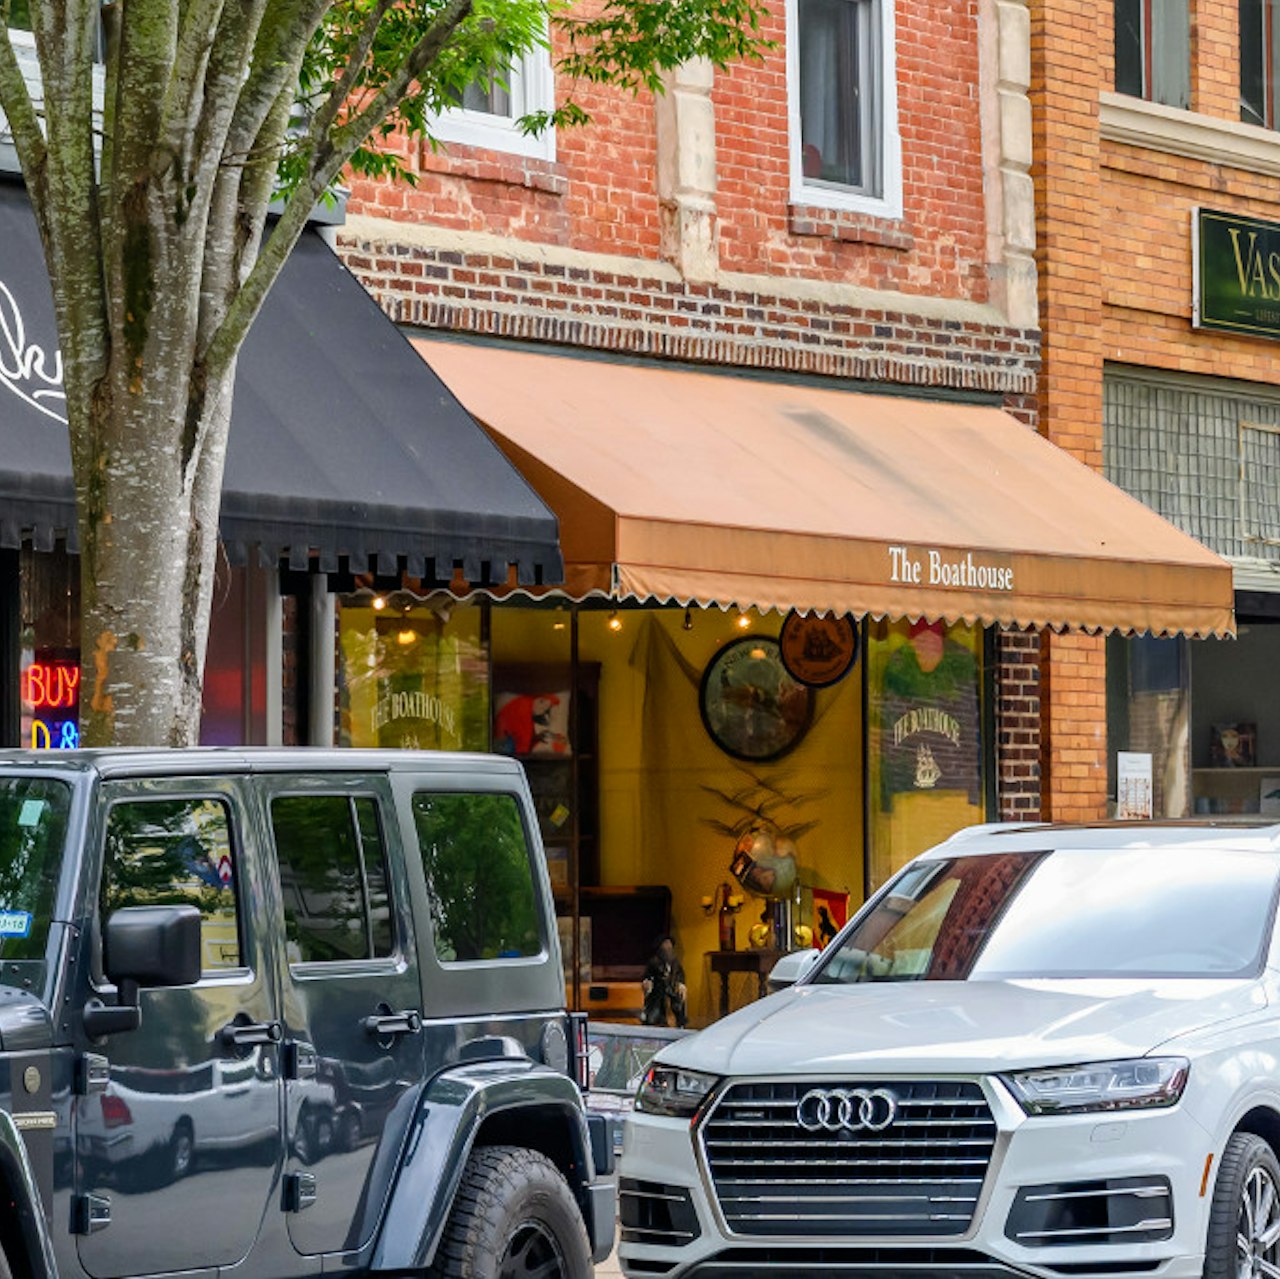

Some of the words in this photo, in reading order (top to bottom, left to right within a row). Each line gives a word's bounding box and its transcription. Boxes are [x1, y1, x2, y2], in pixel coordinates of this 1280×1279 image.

[888, 546, 922, 584] The
[928, 550, 1014, 590] Boathouse
[27, 663, 80, 707] BUY
